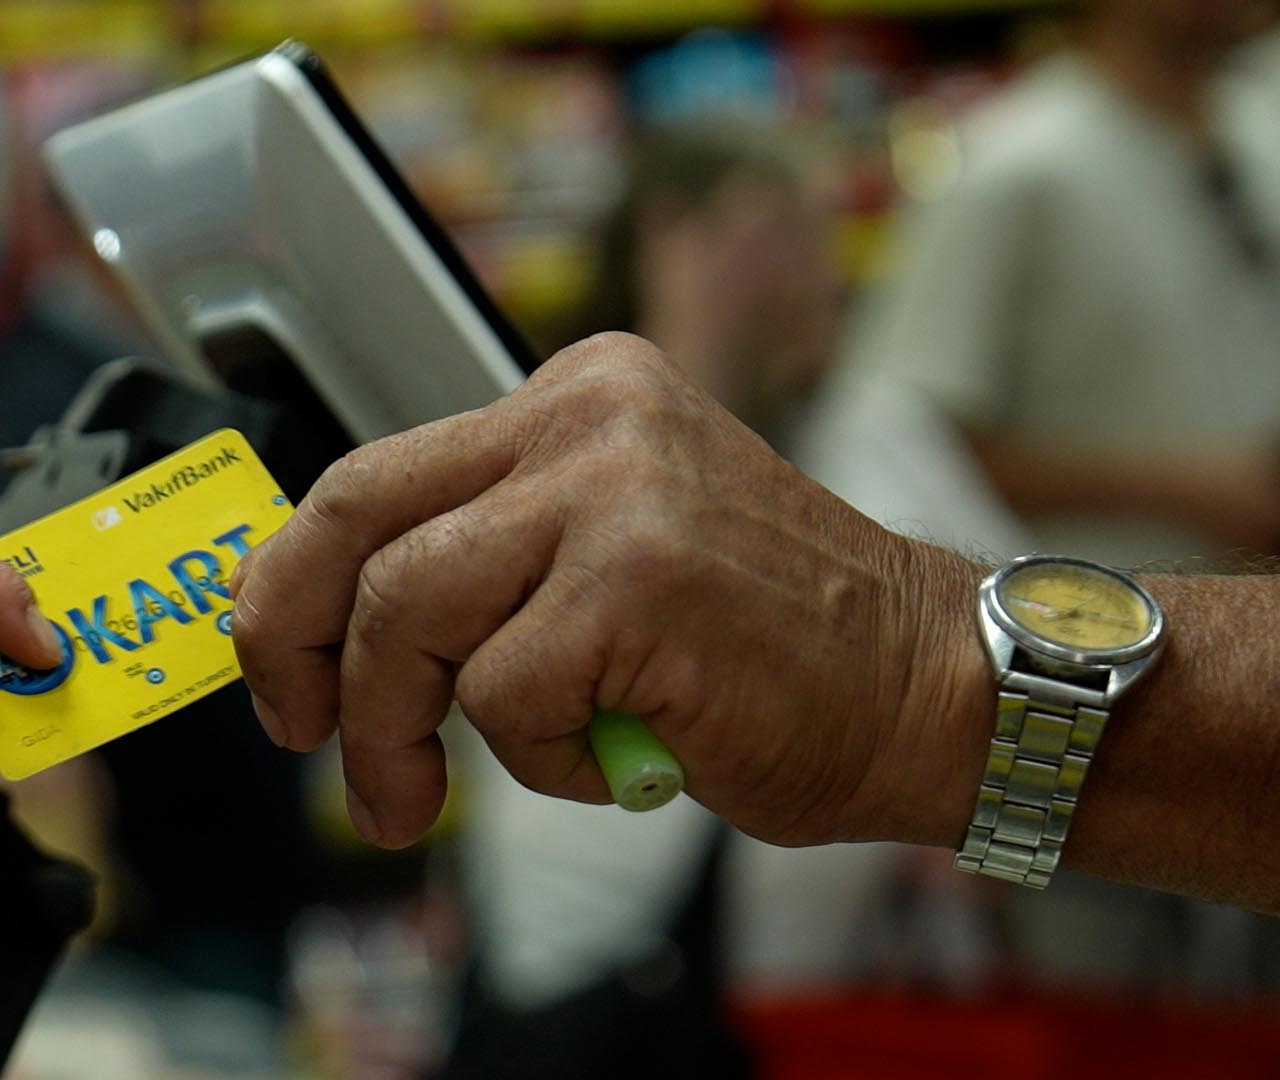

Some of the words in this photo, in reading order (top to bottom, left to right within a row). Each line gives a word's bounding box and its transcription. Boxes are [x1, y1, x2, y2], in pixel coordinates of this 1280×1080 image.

[64, 523, 253, 665] KART
[159, 691, 184, 708] ONLY
[195, 665, 235, 688] TURKEY
